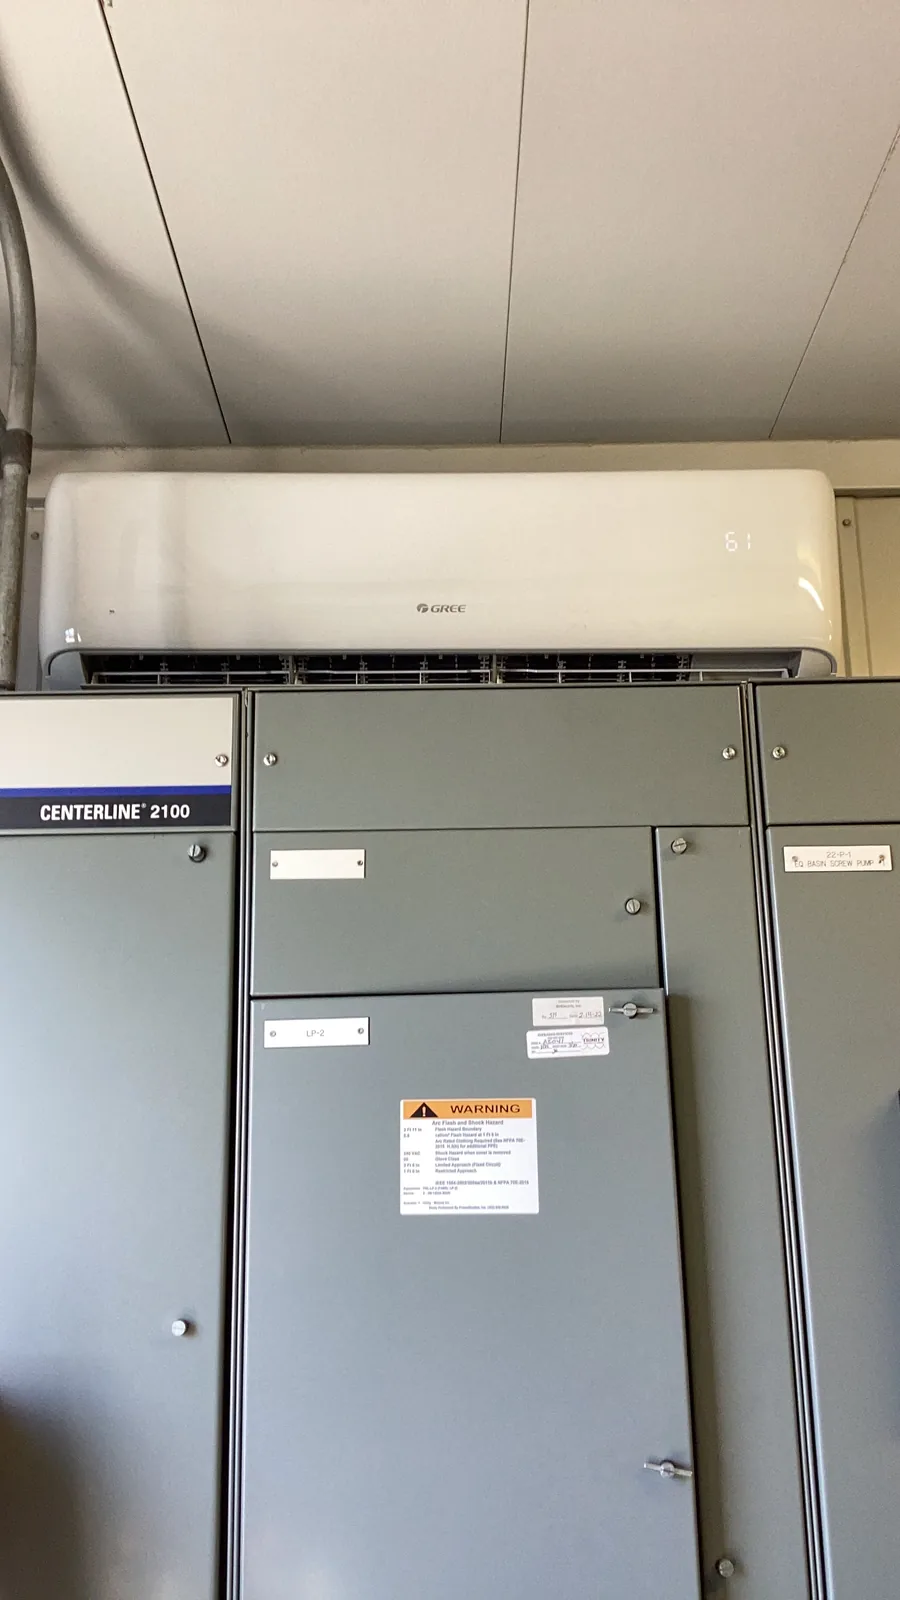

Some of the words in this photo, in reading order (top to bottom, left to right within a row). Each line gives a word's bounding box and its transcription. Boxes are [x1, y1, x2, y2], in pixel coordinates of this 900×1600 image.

[725, 531, 751, 552] 61
[430, 604, 466, 613] GREE
[150, 804, 190, 819] 2100
[826, 851, 852, 859] 22-P-1
[807, 859, 827, 868] BASIN
[830, 859, 853, 867] SCREW
[856, 859, 874, 867] PUMP
[306, 1029, 325, 1037] LP-2
[450, 1104, 521, 1114] WARNING
